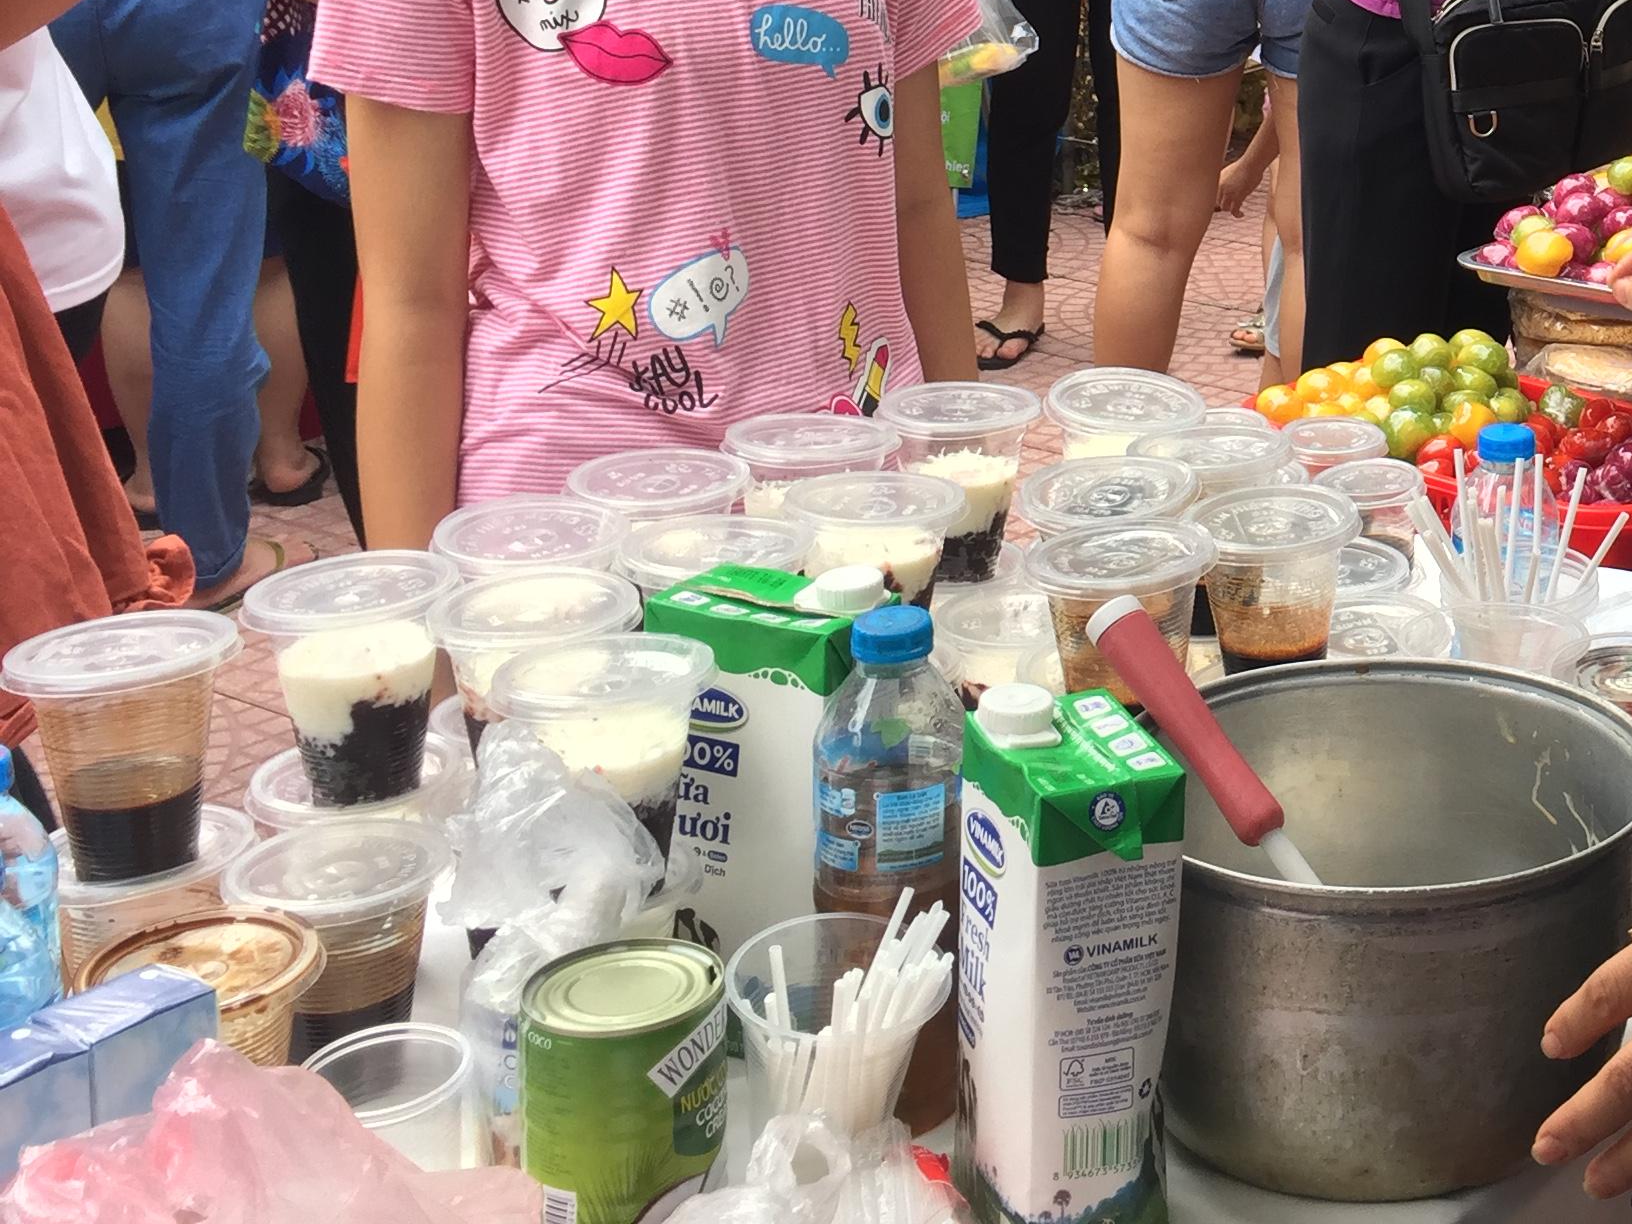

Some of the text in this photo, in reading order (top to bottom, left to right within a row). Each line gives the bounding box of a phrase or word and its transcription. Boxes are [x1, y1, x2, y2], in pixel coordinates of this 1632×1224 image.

[540, 9, 580, 32] mix
[678, 774, 710, 805] ữa
[678, 811, 731, 845] ươi
[969, 814, 1005, 866] VINAMILK
[963, 864, 996, 922] 100%
[960, 902, 990, 962] Fresh
[1086, 933, 1158, 957] VINAMILK
[960, 936, 987, 1002] Milk
